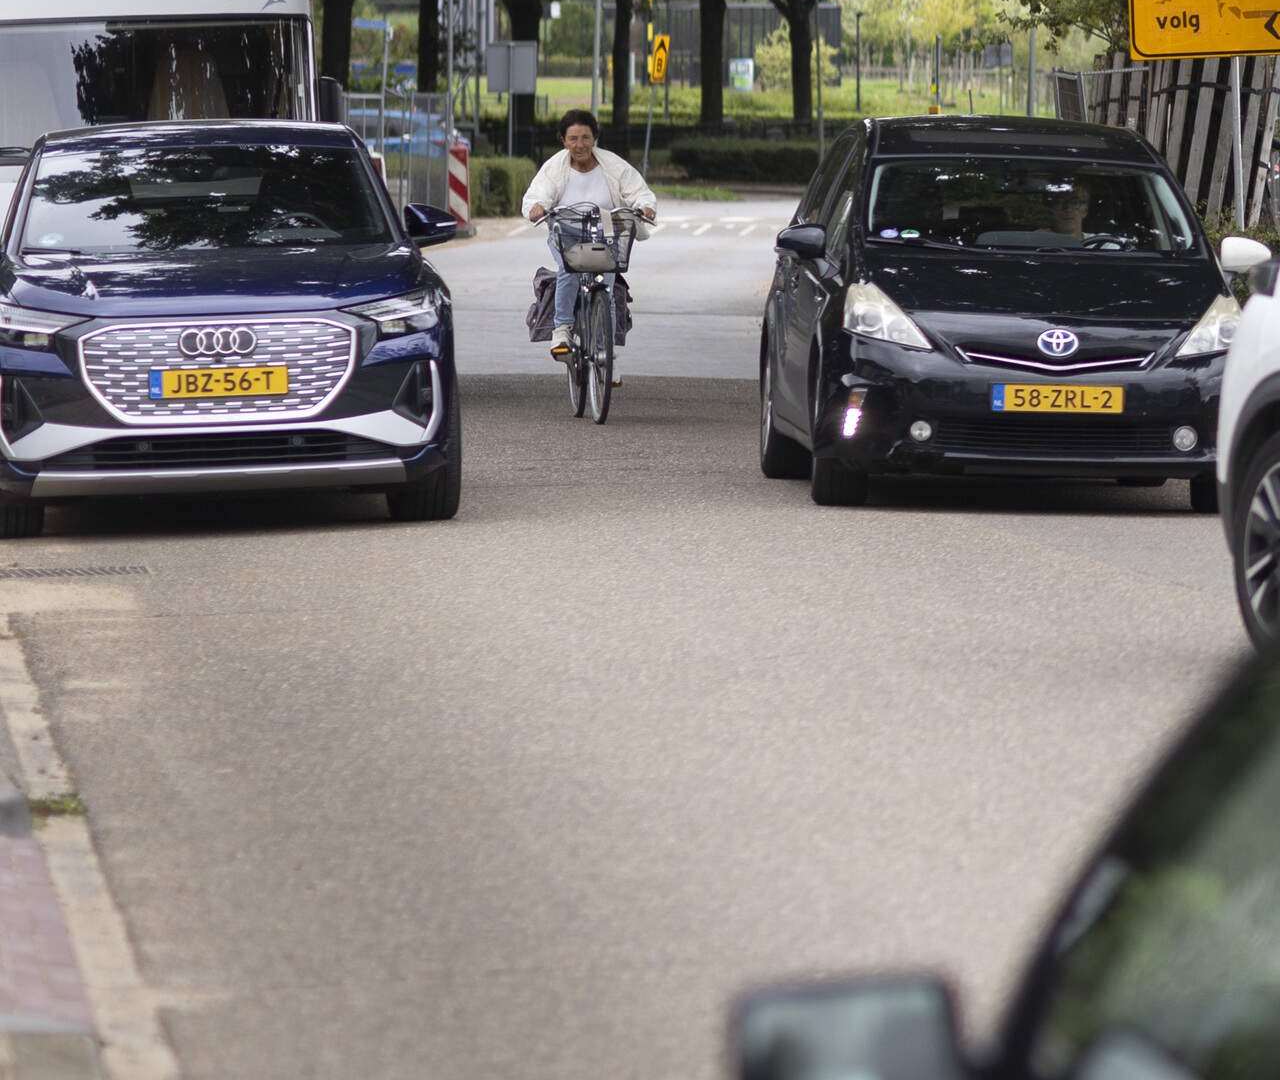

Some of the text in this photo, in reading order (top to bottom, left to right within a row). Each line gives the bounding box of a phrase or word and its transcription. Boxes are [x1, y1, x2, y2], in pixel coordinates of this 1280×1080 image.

[1156, 11, 1200, 33] volg
[171, 371, 274, 393] JBZ-56-T
[1013, 388, 1113, 409] 58-ZRL-2
